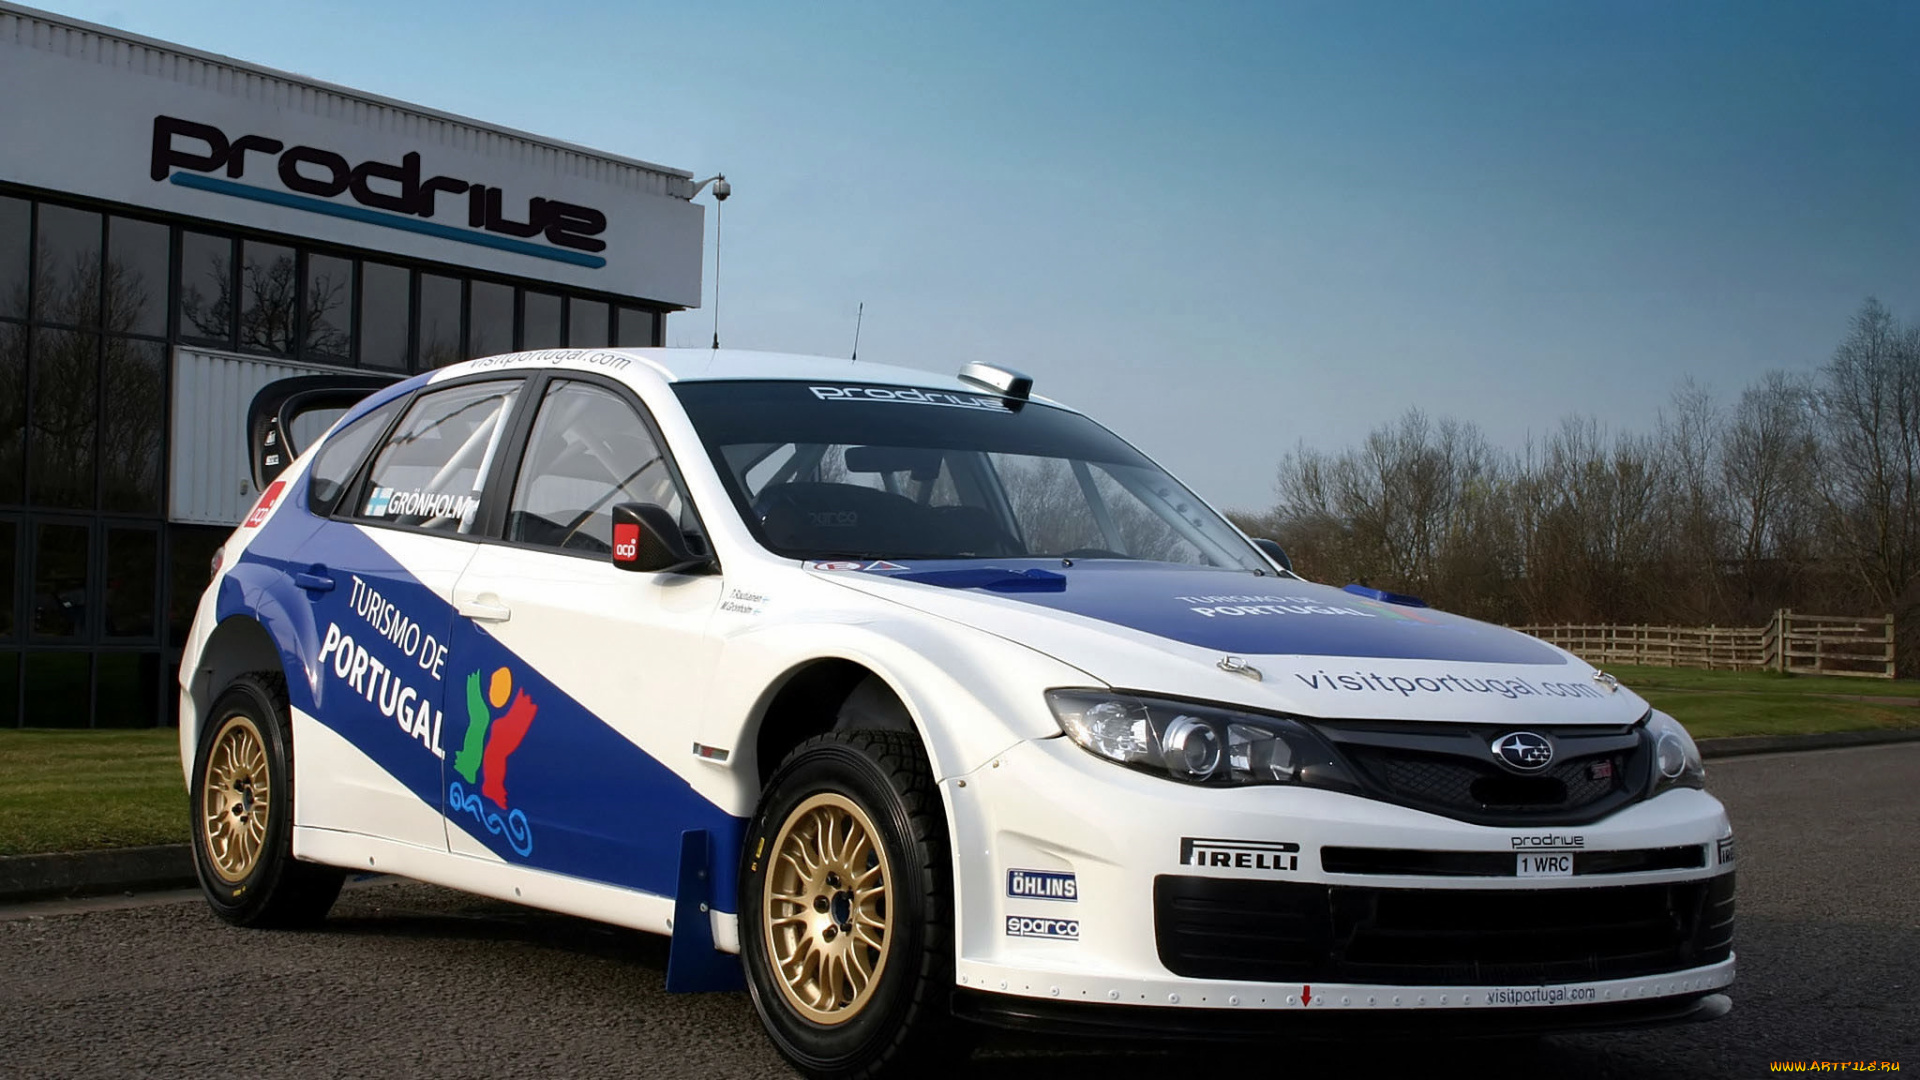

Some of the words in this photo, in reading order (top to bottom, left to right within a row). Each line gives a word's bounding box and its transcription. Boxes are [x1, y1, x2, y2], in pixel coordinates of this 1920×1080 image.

[150, 114, 607, 252] prodrive
[809, 386, 1011, 411] prodrive
[388, 488, 473, 519] GRÖNHOLM
[1173, 595, 1289, 605] TURISMO
[1189, 605, 1377, 618] PORTUGAL
[350, 575, 421, 657] TURISMO
[418, 634, 448, 681] DE
[318, 622, 446, 760] PORTUGAL
[1295, 669, 1603, 699] visitportugal.com
[1510, 833, 1585, 849] prodrive
[1179, 837, 1300, 871] PIRELLI
[1521, 857, 1529, 873] 1
[1534, 856, 1569, 872] WRC
[1012, 871, 1076, 897] ÖHLINS
[1007, 917, 1079, 936] sparco
[1487, 986, 1595, 1006] visitportugal.com
